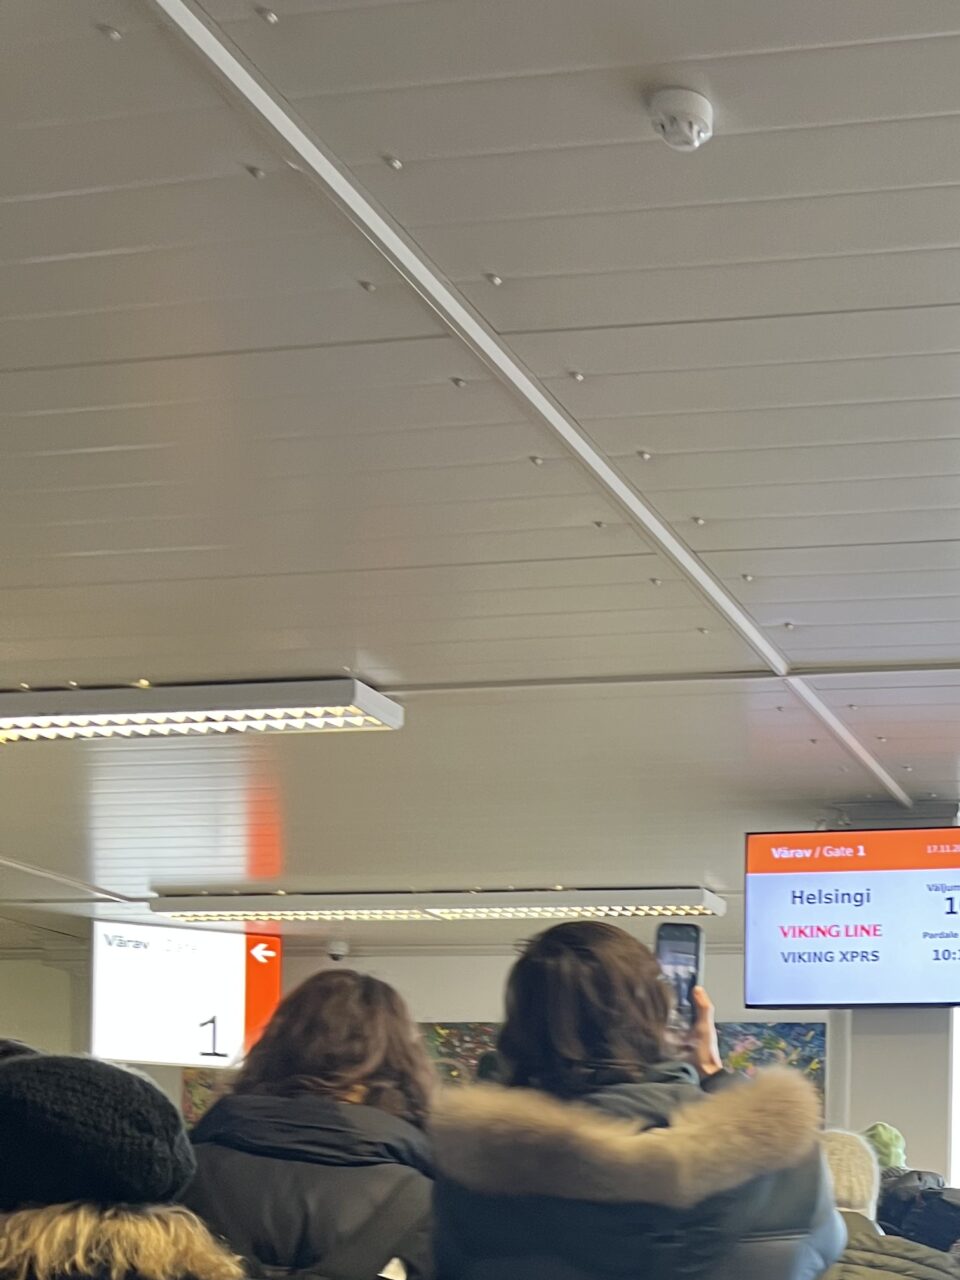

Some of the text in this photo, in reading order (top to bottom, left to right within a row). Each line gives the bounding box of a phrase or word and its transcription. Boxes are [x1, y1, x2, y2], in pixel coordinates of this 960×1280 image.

[771, 846, 812, 859] Värav
[823, 845, 854, 857] Gate
[857, 845, 865, 856] 1
[791, 888, 871, 907] Helsingi
[779, 924, 882, 938] VIKING LINE
[780, 950, 880, 963] VIKING XPRS
[199, 1015, 228, 1057] 1
